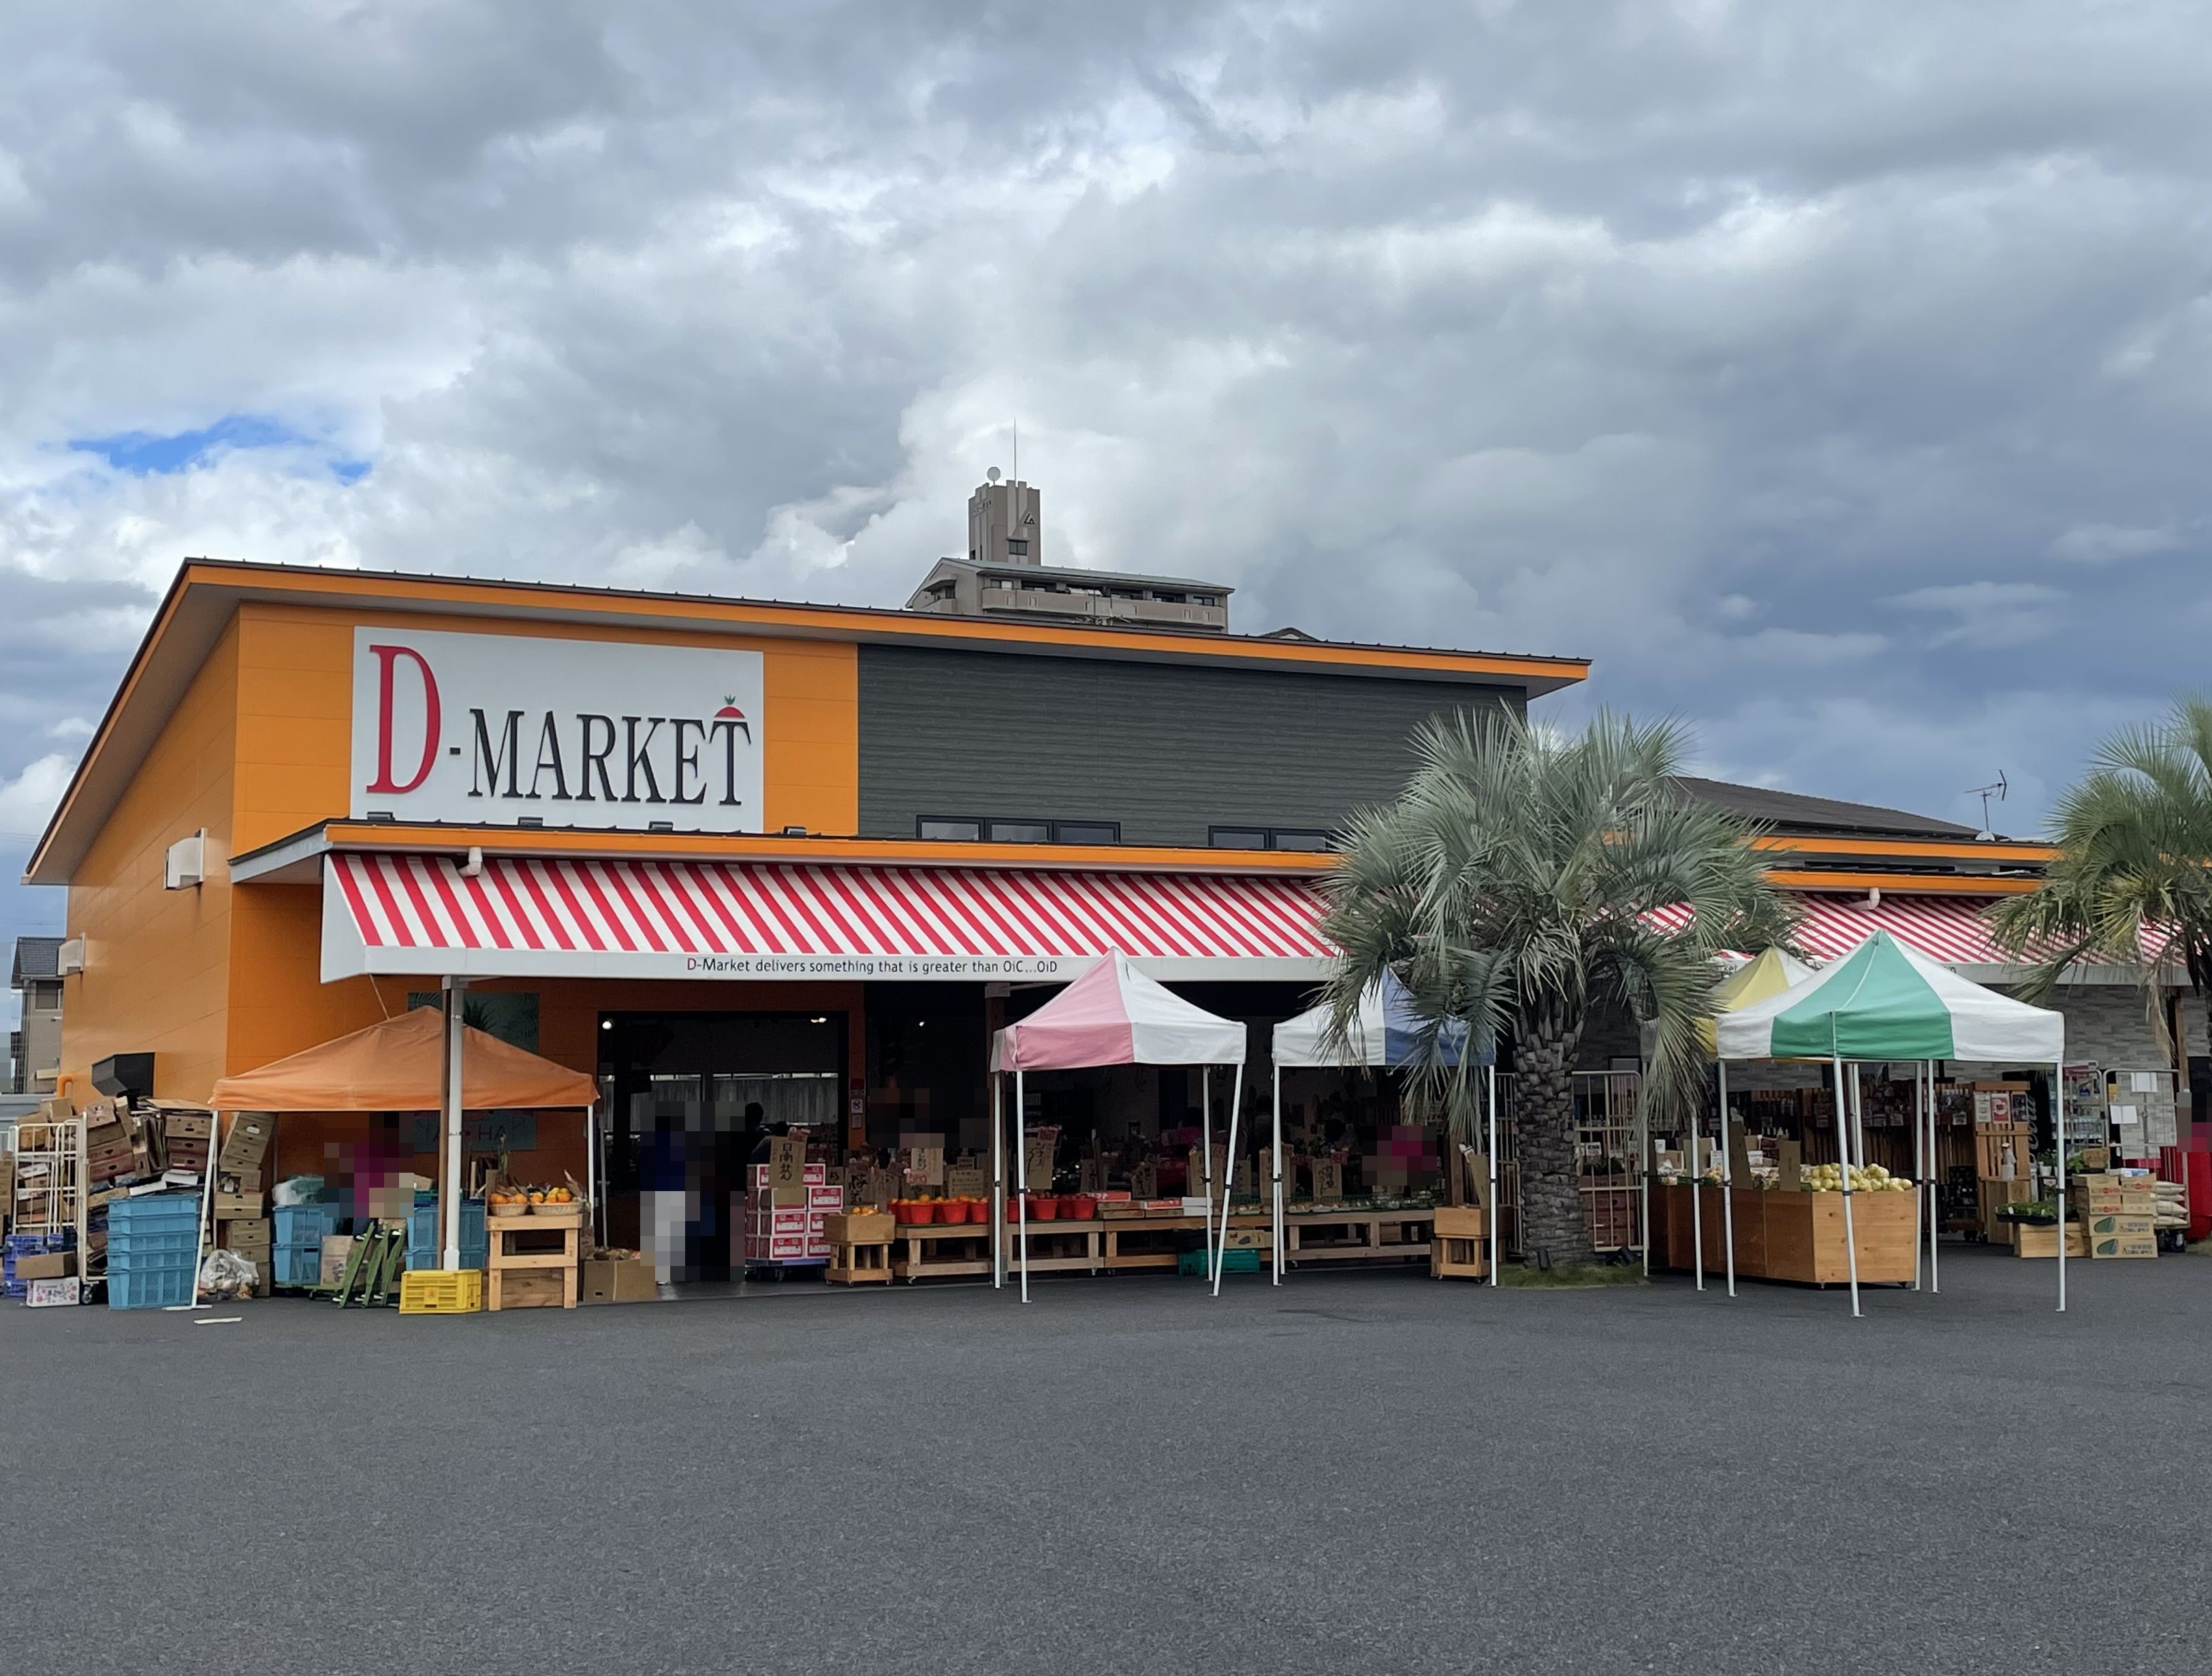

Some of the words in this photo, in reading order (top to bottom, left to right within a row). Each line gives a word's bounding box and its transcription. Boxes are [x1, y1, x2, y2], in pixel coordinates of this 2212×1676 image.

[686, 958, 750, 972] D-Market
[755, 959, 806, 973] delivers
[810, 960, 874, 975] something
[879, 960, 903, 973] that
[908, 961, 918, 973] is
[922, 961, 968, 975] greater
[972, 960, 998, 973] than
